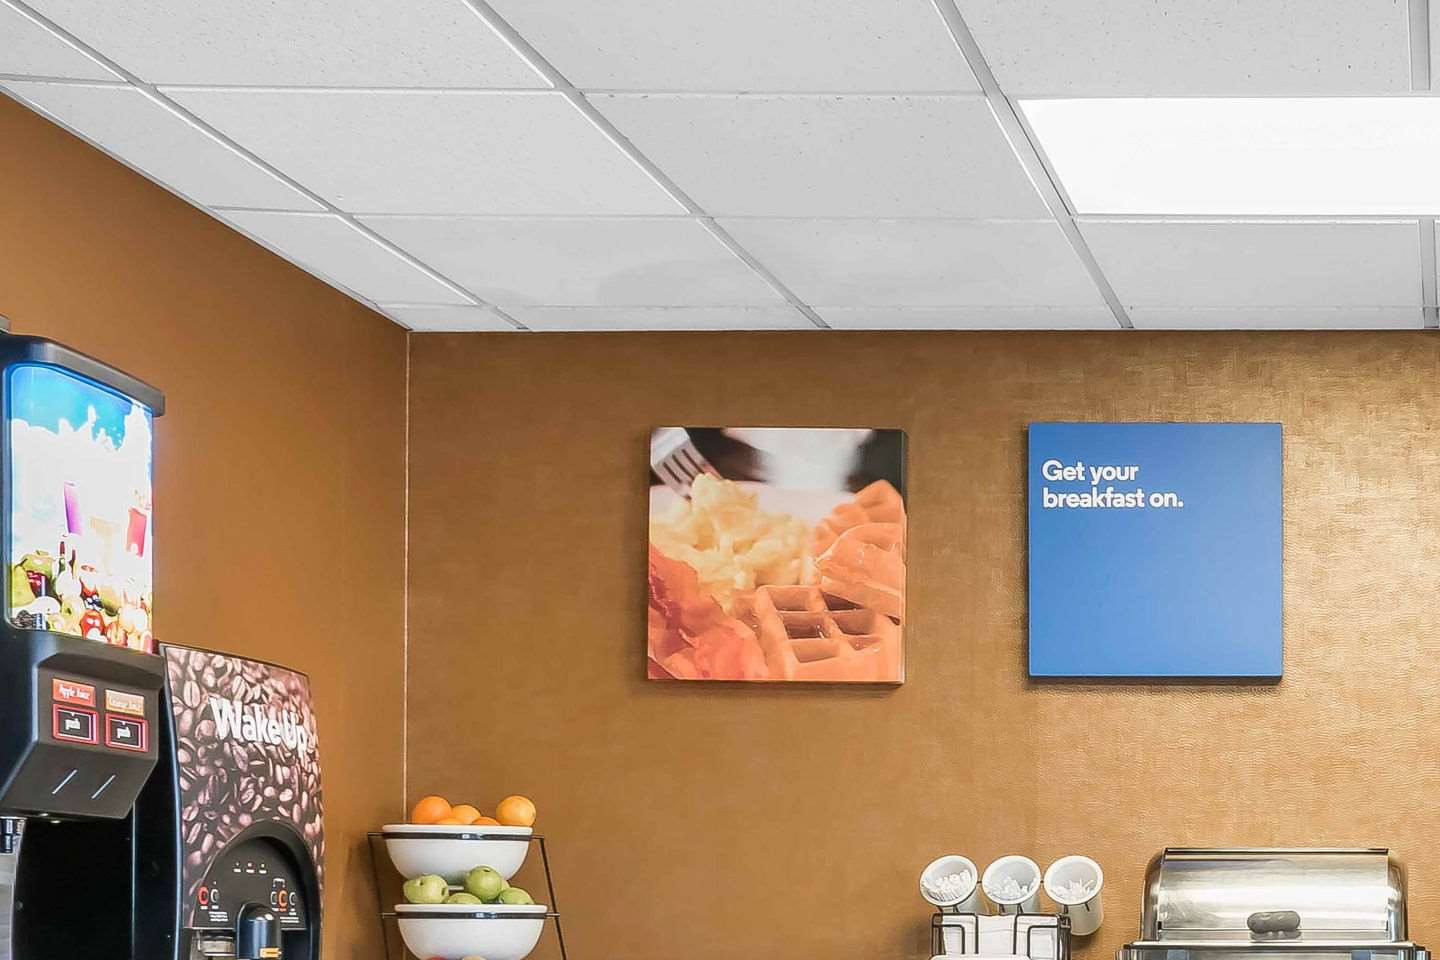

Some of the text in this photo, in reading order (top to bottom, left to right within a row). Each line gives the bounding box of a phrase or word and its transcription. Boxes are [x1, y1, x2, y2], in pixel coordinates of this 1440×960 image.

[1042, 459, 1140, 485] Get your
[1042, 486, 1185, 508] breakfast on.
[209, 697, 309, 760] Wake Up
